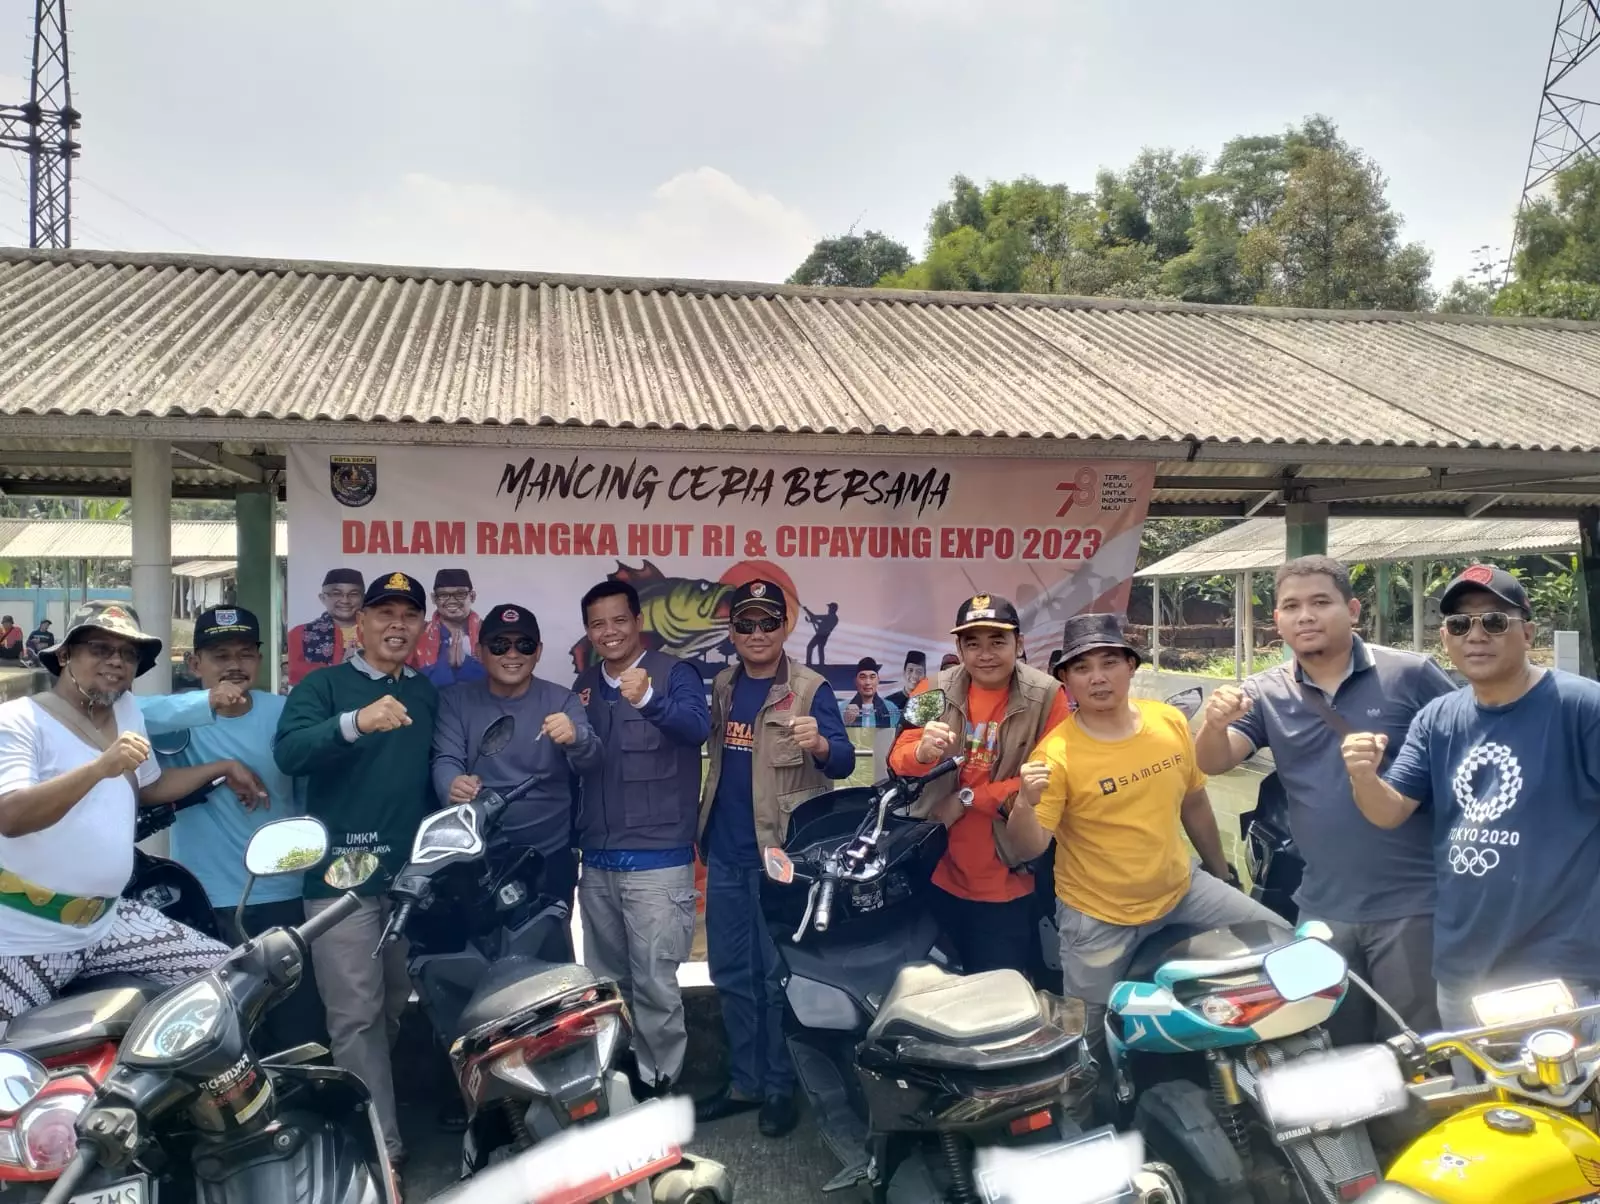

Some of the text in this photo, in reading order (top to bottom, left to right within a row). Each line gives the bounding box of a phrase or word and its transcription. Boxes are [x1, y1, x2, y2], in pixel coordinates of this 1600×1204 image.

[496, 456, 951, 519] MANCING CERIA BERSAMA
[342, 519, 1102, 560] DALAM RANGKA HUT RI & CIPAYUNG EXPO 2023
[346, 831, 378, 845] UMKM
[1479, 829, 1520, 847] 2020
[1285, 1125, 1312, 1140] YAMAHA
